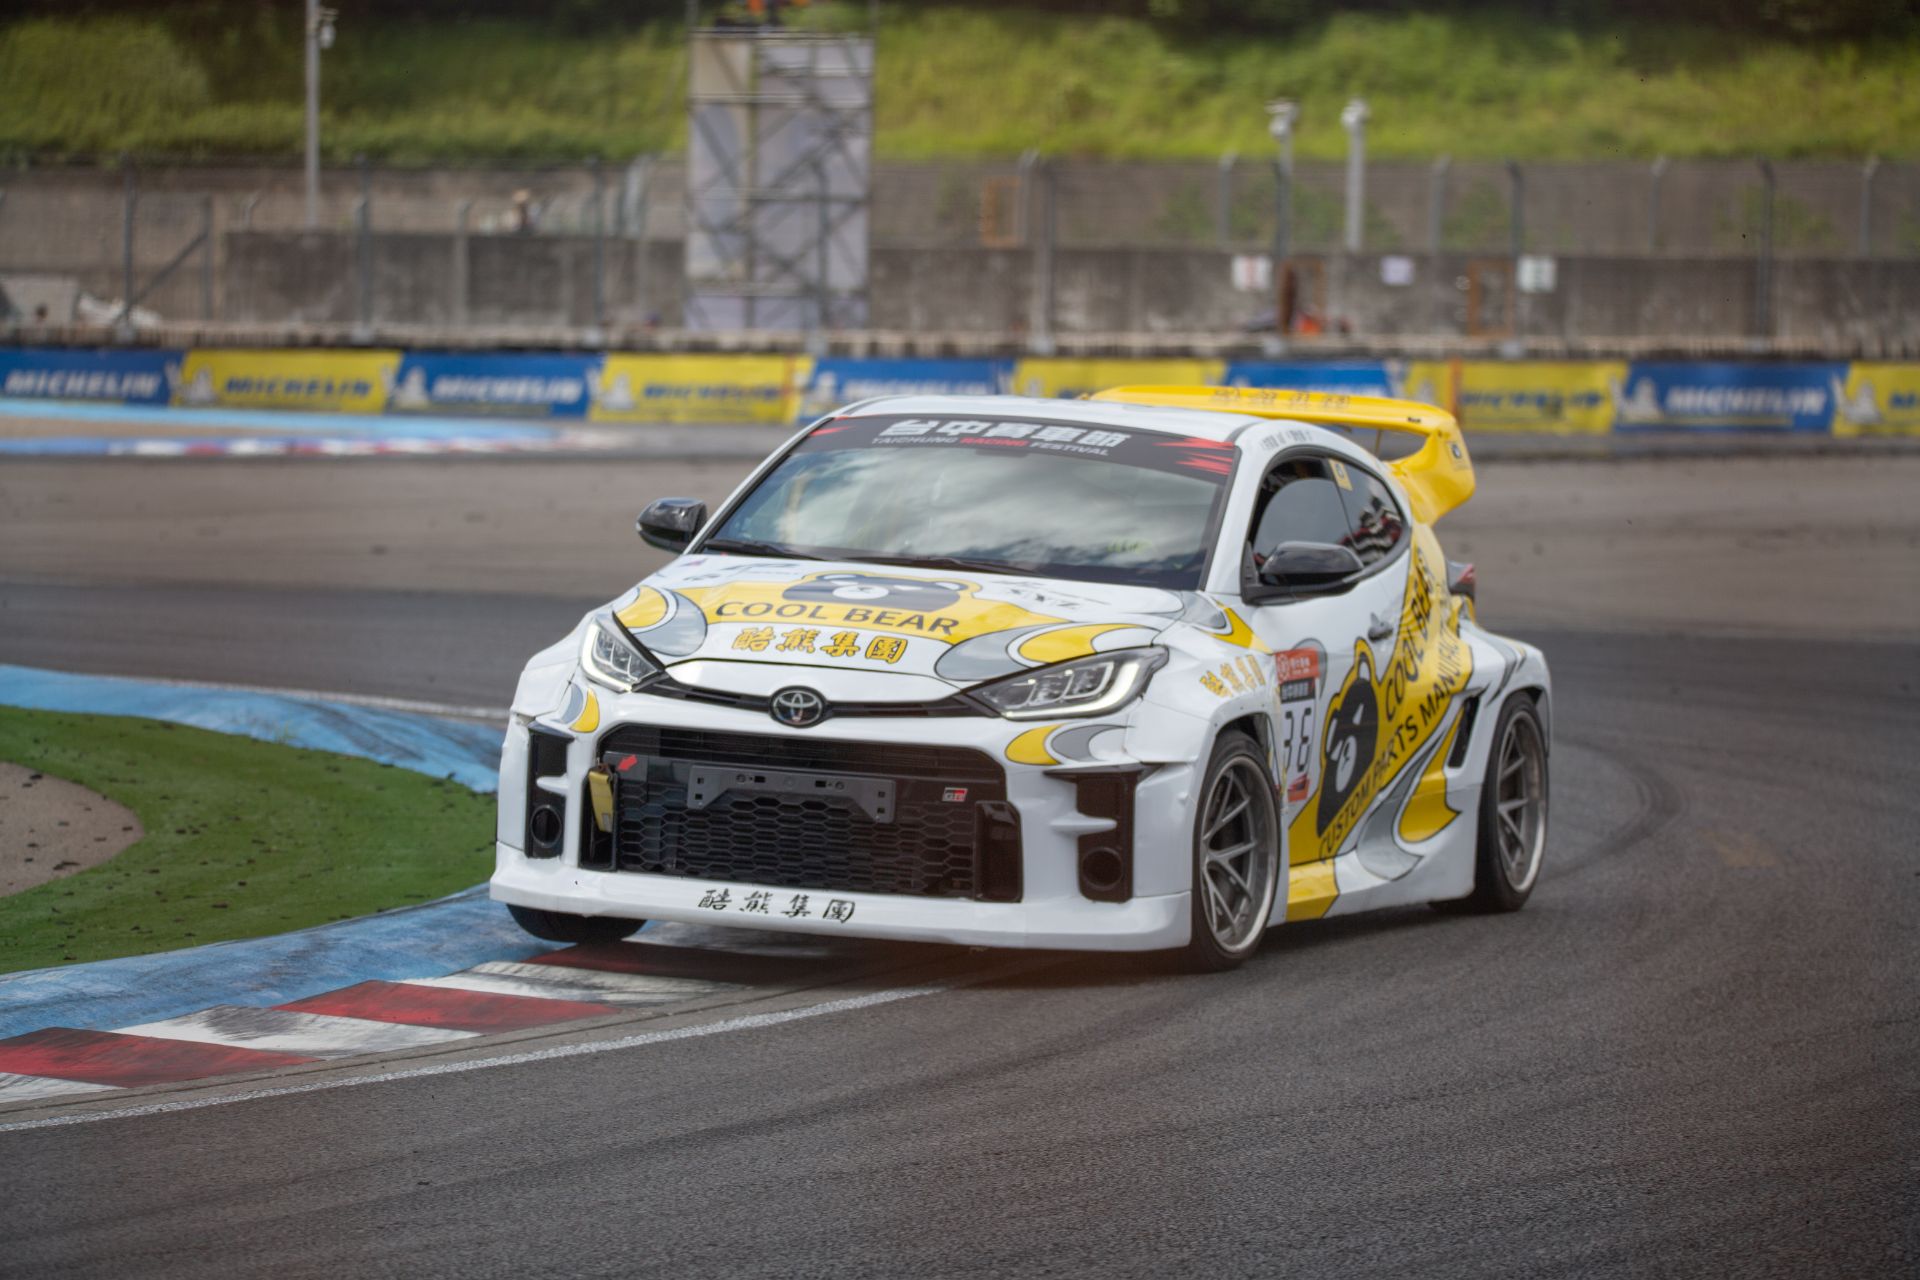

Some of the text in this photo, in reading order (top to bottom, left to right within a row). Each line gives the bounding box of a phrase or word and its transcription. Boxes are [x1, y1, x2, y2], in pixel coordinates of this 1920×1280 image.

[958, 436, 1031, 447] RACING
[1029, 440, 1110, 457] FESTIVAL
[715, 600, 960, 636] COOL BEAR
[731, 626, 909, 664] 酷熊集團
[698, 887, 856, 924] 酷熊集團
